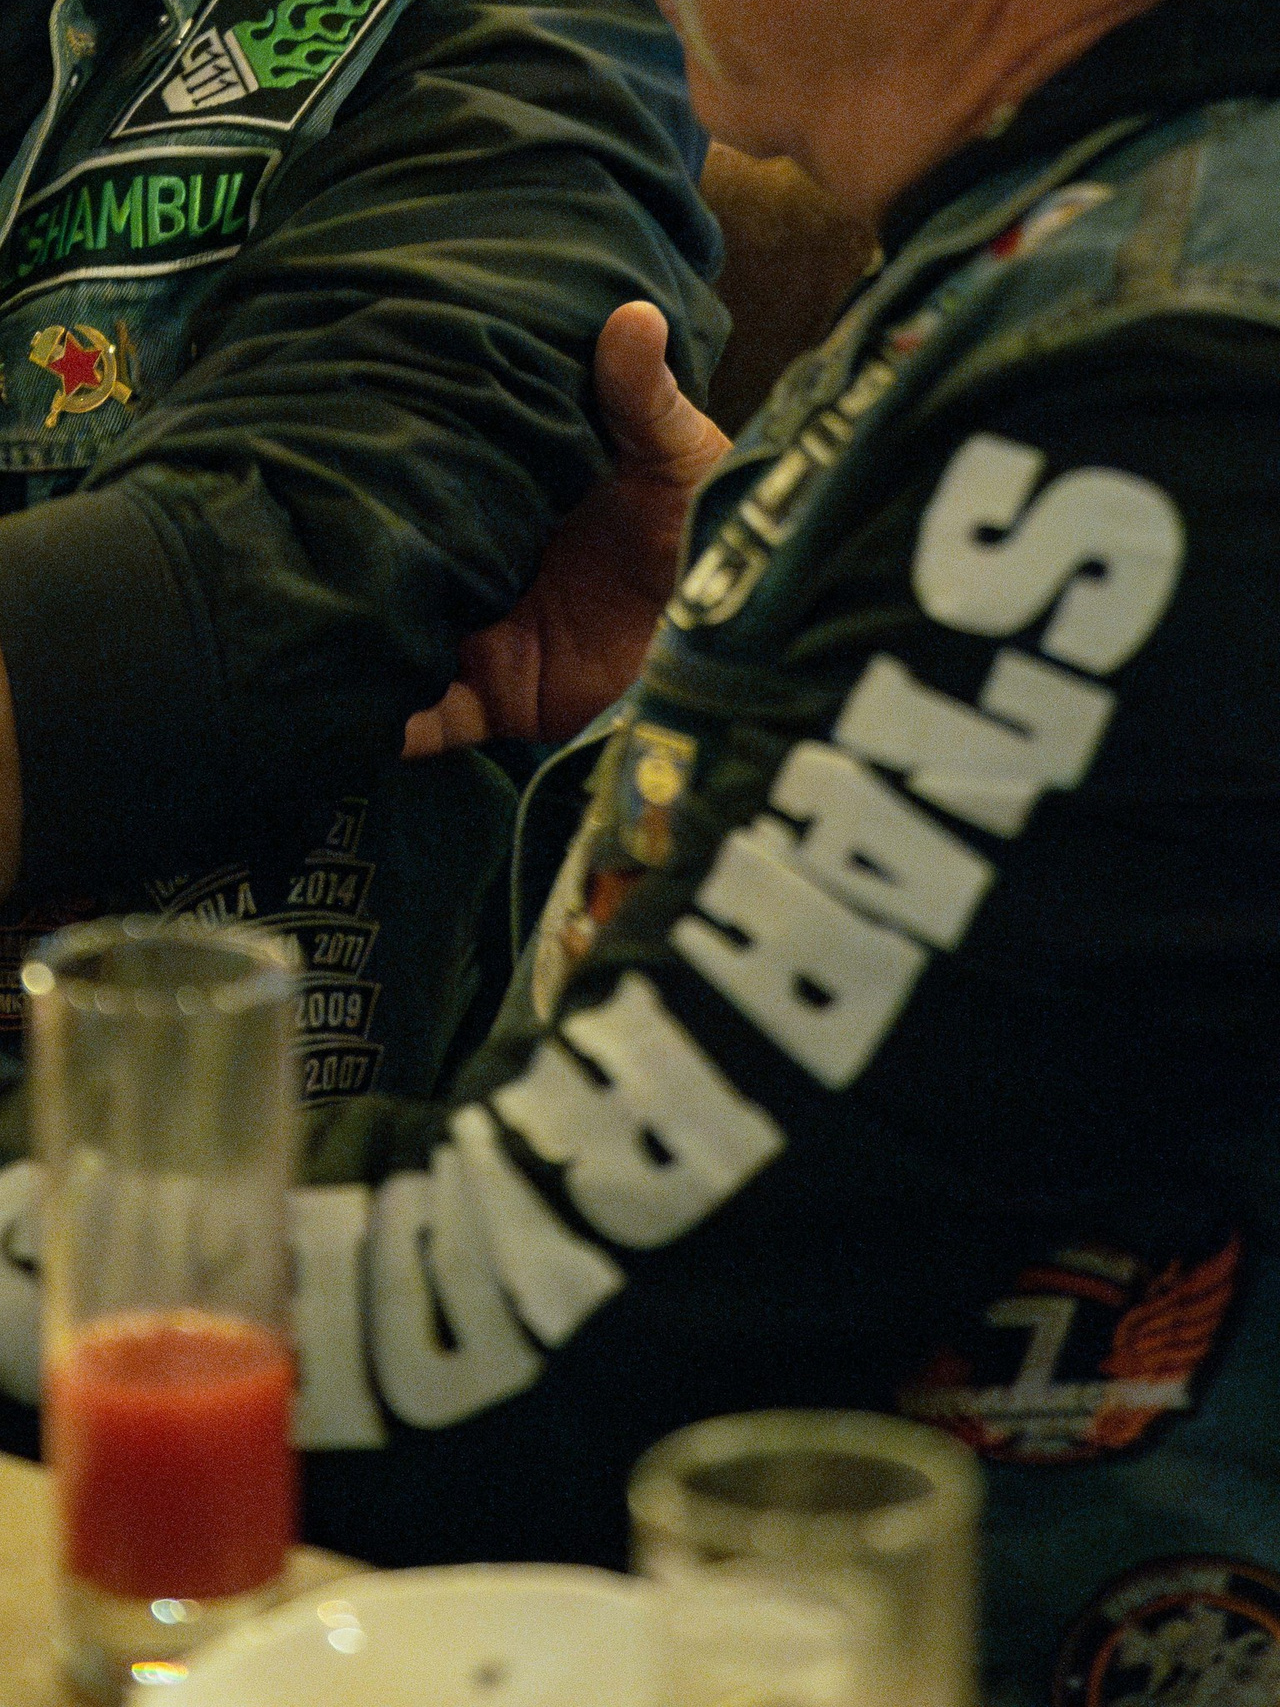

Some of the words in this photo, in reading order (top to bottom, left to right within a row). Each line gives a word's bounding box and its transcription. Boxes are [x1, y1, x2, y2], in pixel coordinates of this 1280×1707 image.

[667, 430, 1187, 1093] STAR
[286, 870, 359, 906] 2014
[313, 931, 366, 968] 2011
[295, 991, 363, 1029] 2009
[305, 1055, 370, 1093] 2007
